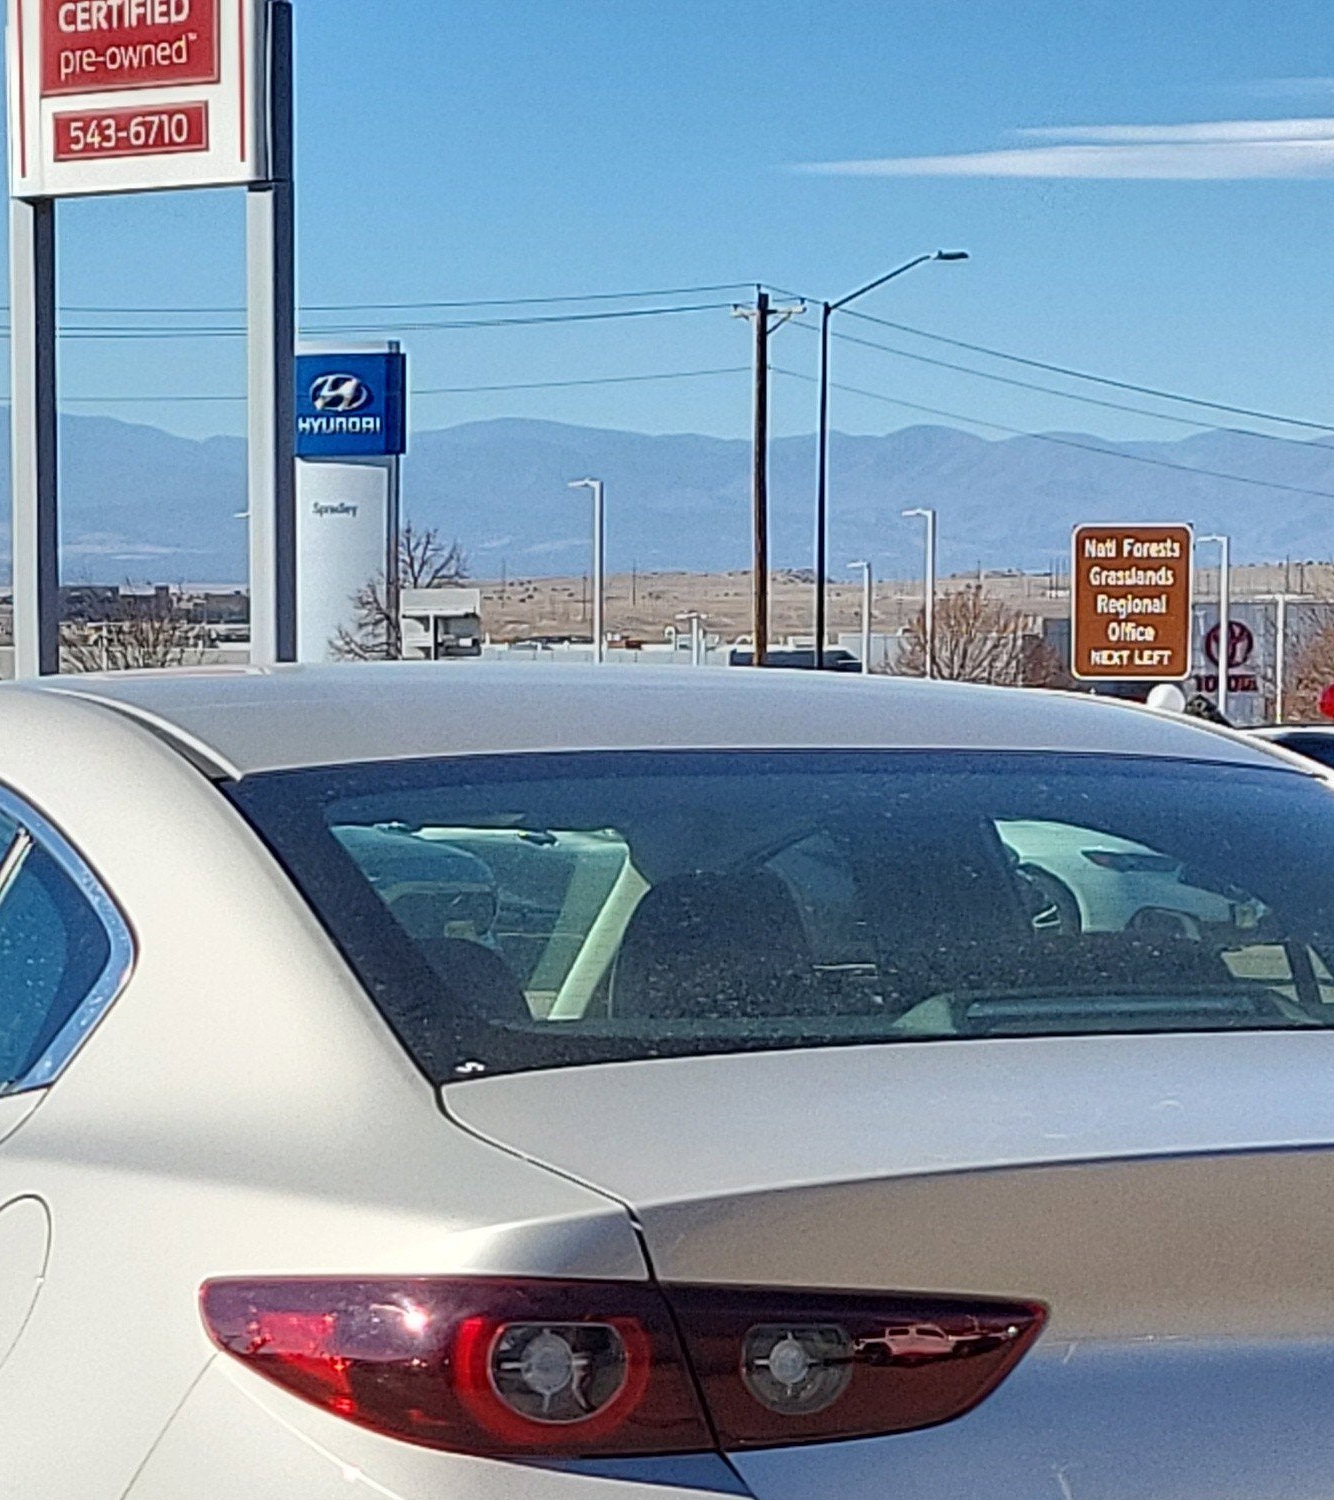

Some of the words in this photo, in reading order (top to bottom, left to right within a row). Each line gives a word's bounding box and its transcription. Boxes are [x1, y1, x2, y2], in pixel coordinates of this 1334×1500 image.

[58, 0, 190, 32] CERTIFIED
[69, 113, 188, 151] 543-6710
[298, 417, 380, 434] HYUNDAI
[1123, 538, 1180, 558] Forests
[1089, 566, 1174, 586] Grasslands
[1097, 594, 1166, 619] Regional
[1108, 622, 1155, 642] Office
[1091, 650, 1130, 665] NEXT
[1134, 650, 1172, 665] LEFT
[1193, 674, 1259, 692] TOOTA
